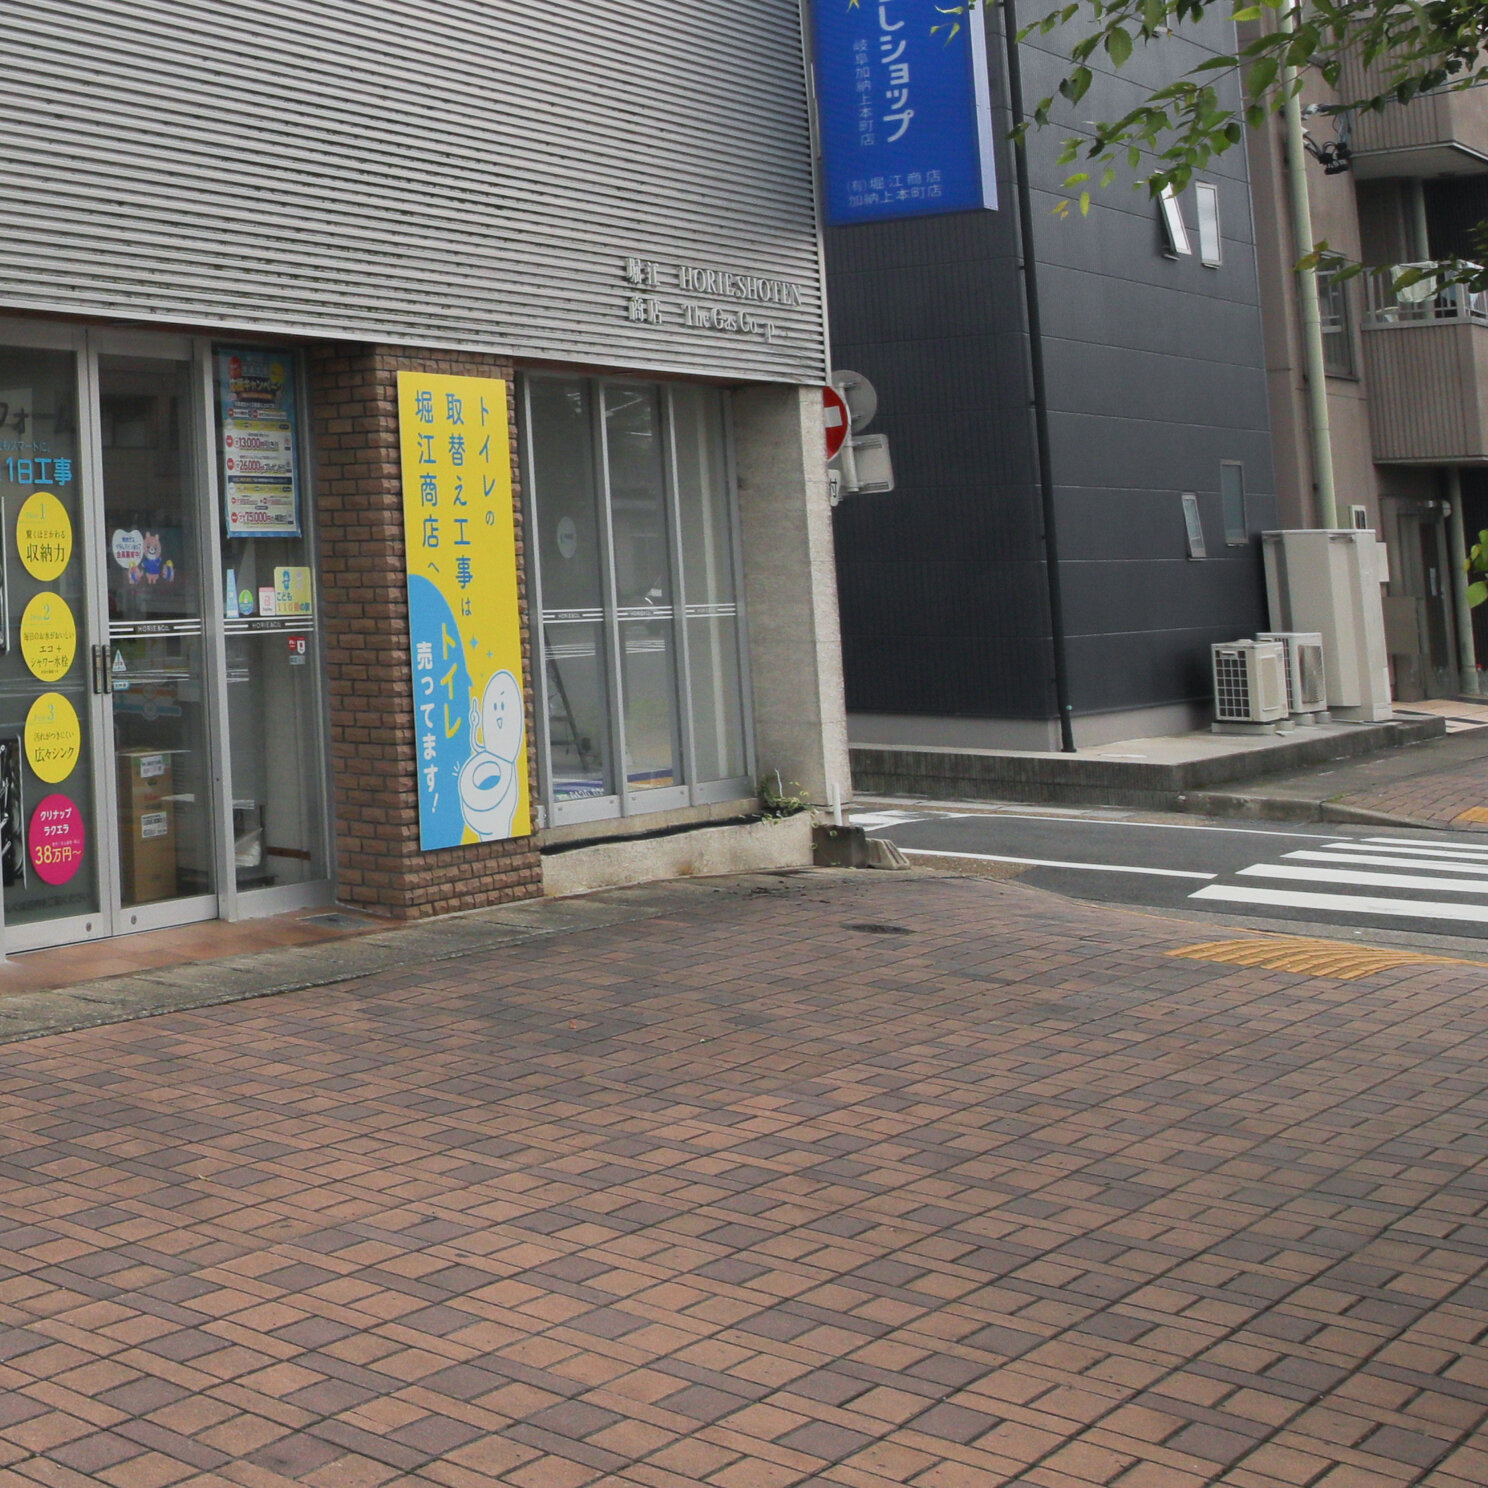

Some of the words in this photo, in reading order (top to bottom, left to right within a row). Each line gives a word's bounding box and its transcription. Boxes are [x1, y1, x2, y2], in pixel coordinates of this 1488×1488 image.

[681, 303, 710, 328] The
[711, 307, 737, 331] Gas
[6, 457, 72, 486] 1日工事
[478, 396, 497, 527] トイレの
[415, 389, 440, 574] 堀江商店へ
[444, 392, 475, 617] 取替え工事は
[26, 543, 65, 563] 収納力
[440, 624, 462, 739] トイレ
[415, 641, 439, 813] 売ってます!
[34, 746, 75, 763] 広々シンク
[40, 808, 72, 821] クリナップ
[43, 824, 70, 836] ラクエラ
